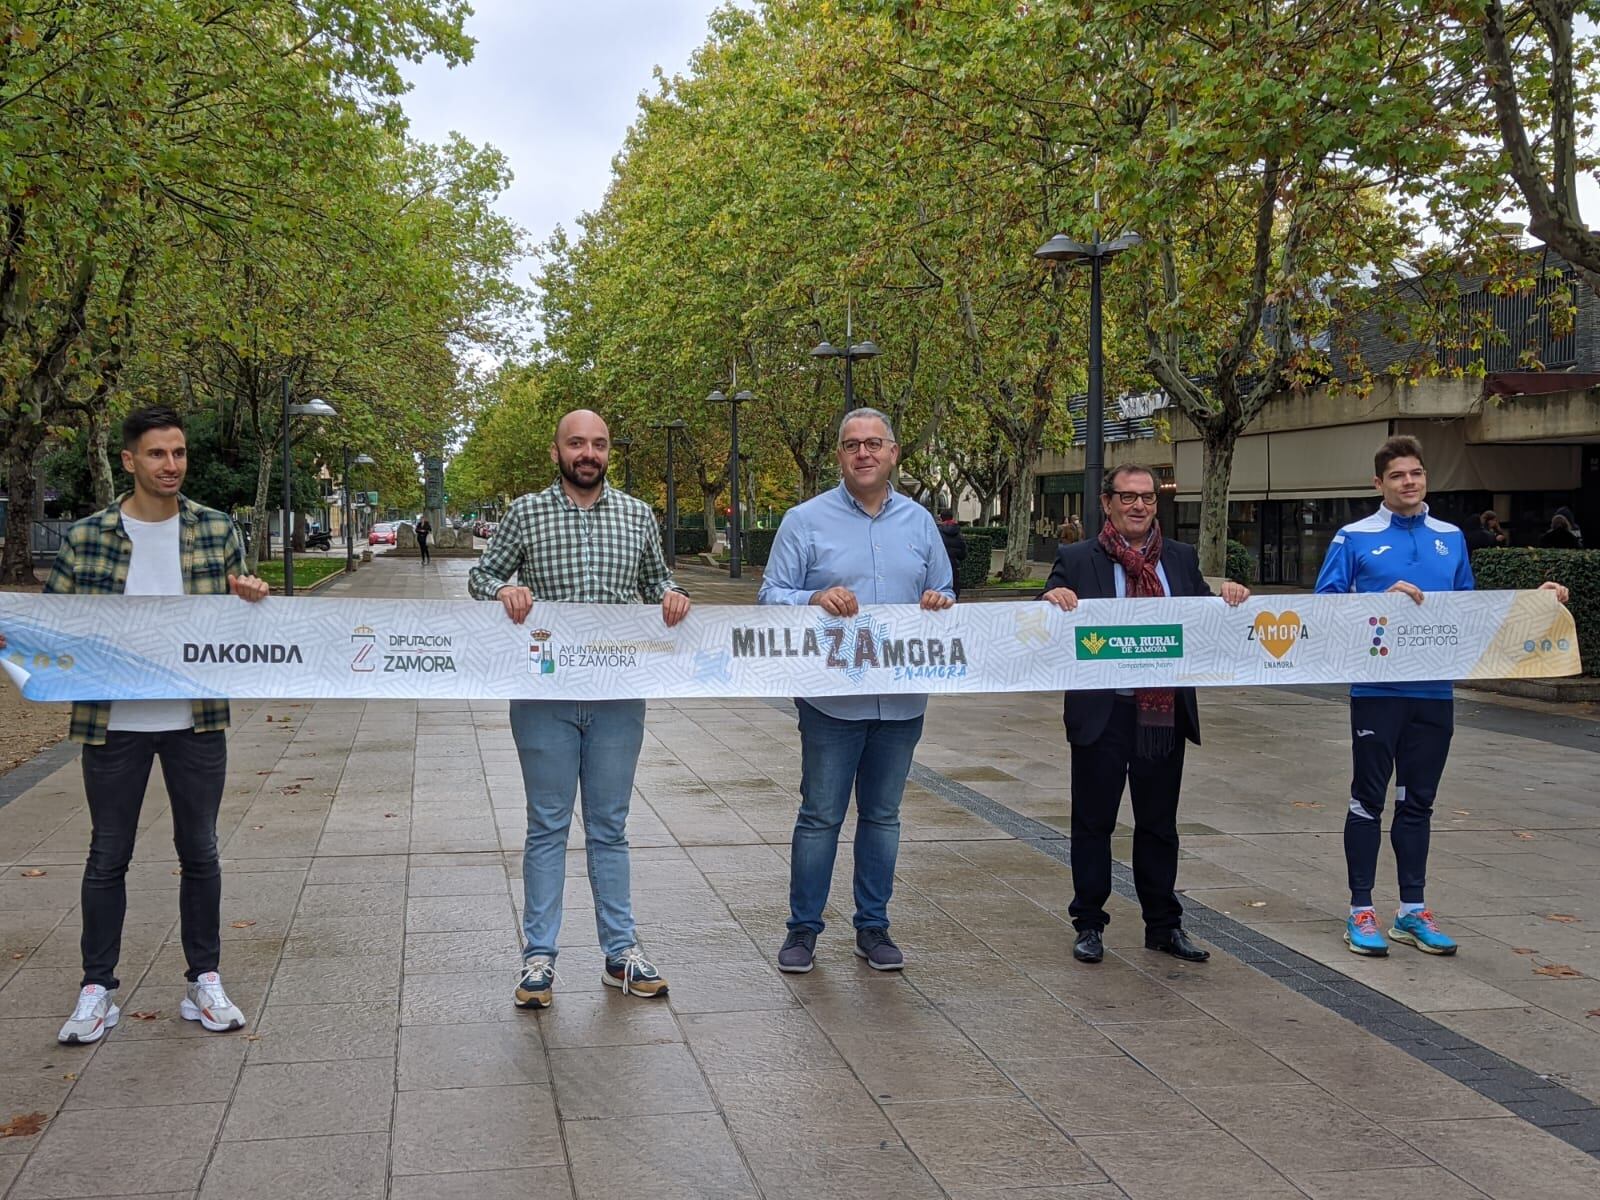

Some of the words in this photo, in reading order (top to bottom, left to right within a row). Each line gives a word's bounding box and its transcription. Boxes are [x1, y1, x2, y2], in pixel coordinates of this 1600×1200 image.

[1247, 624, 1309, 641] ZAMORA
[1397, 624, 1458, 636] alimentos
[1108, 637, 1138, 648] CAJA
[1139, 636, 1179, 647] RURAL
[1408, 635, 1458, 647] zamora
[183, 643, 303, 664] DAKONDA
[559, 645, 637, 656] AYUNTAMIENTO
[1121, 646, 1133, 654] DE
[383, 655, 457, 673] ZAMORA
[559, 655, 576, 667] DE
[579, 655, 637, 667] ZAMORA
[1263, 661, 1294, 670] ENAMORA
[894, 665, 967, 681] ENAMORA
